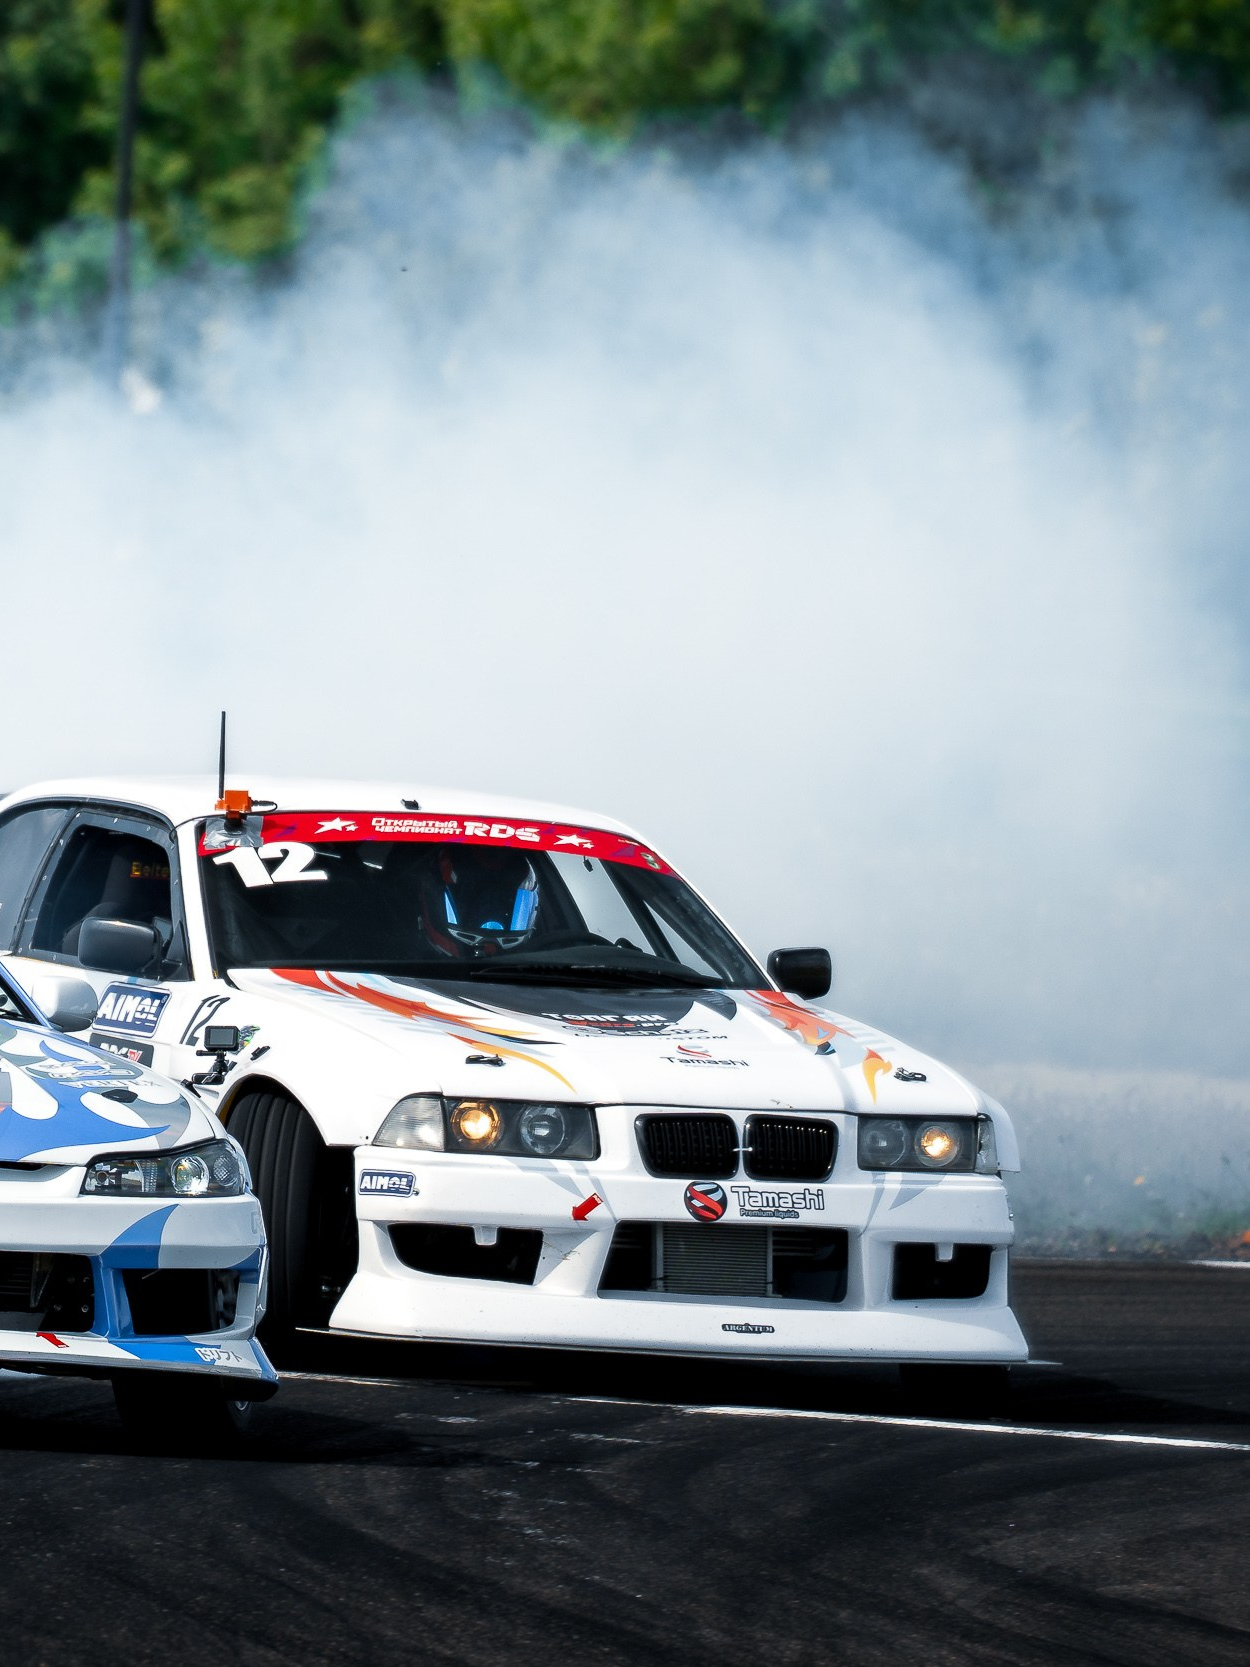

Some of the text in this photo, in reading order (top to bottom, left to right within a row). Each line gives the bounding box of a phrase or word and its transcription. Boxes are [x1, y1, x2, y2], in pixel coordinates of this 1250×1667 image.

[463, 821, 540, 842] RDS
[212, 841, 328, 888] 12
[97, 992, 160, 1027] AIMOL
[660, 1056, 750, 1067] Tamashi
[360, 1175, 410, 1192] AIMOL
[731, 1186, 825, 1210] Tamashi
[739, 1208, 800, 1219] Premium liquids
[723, 1324, 773, 1332] ARGENTUM
